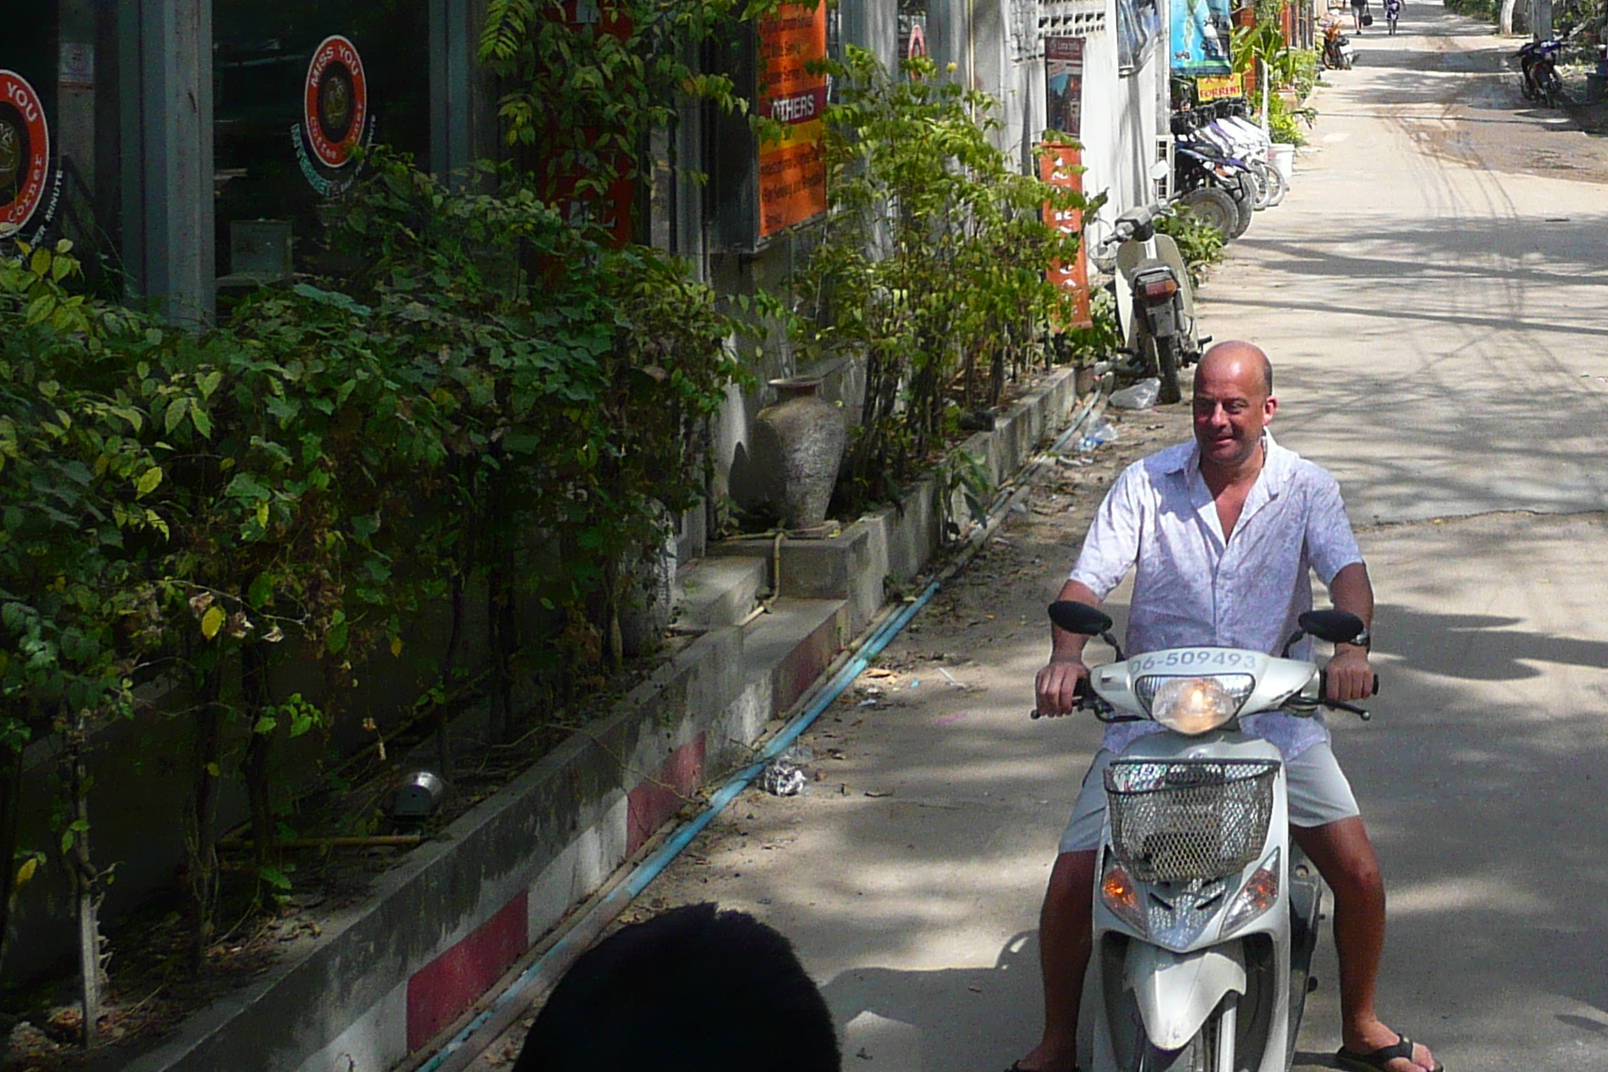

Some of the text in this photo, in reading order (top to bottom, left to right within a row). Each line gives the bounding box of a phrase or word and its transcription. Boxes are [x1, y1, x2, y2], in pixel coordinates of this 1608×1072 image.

[311, 44, 359, 88] MISS YOU
[6, 81, 38, 121] YOU
[771, 94, 815, 122] OTHERS
[8, 154, 42, 222] Corner
[45, 170, 64, 222] MINUTE
[1128, 649, 1257, 675] 06-509493
